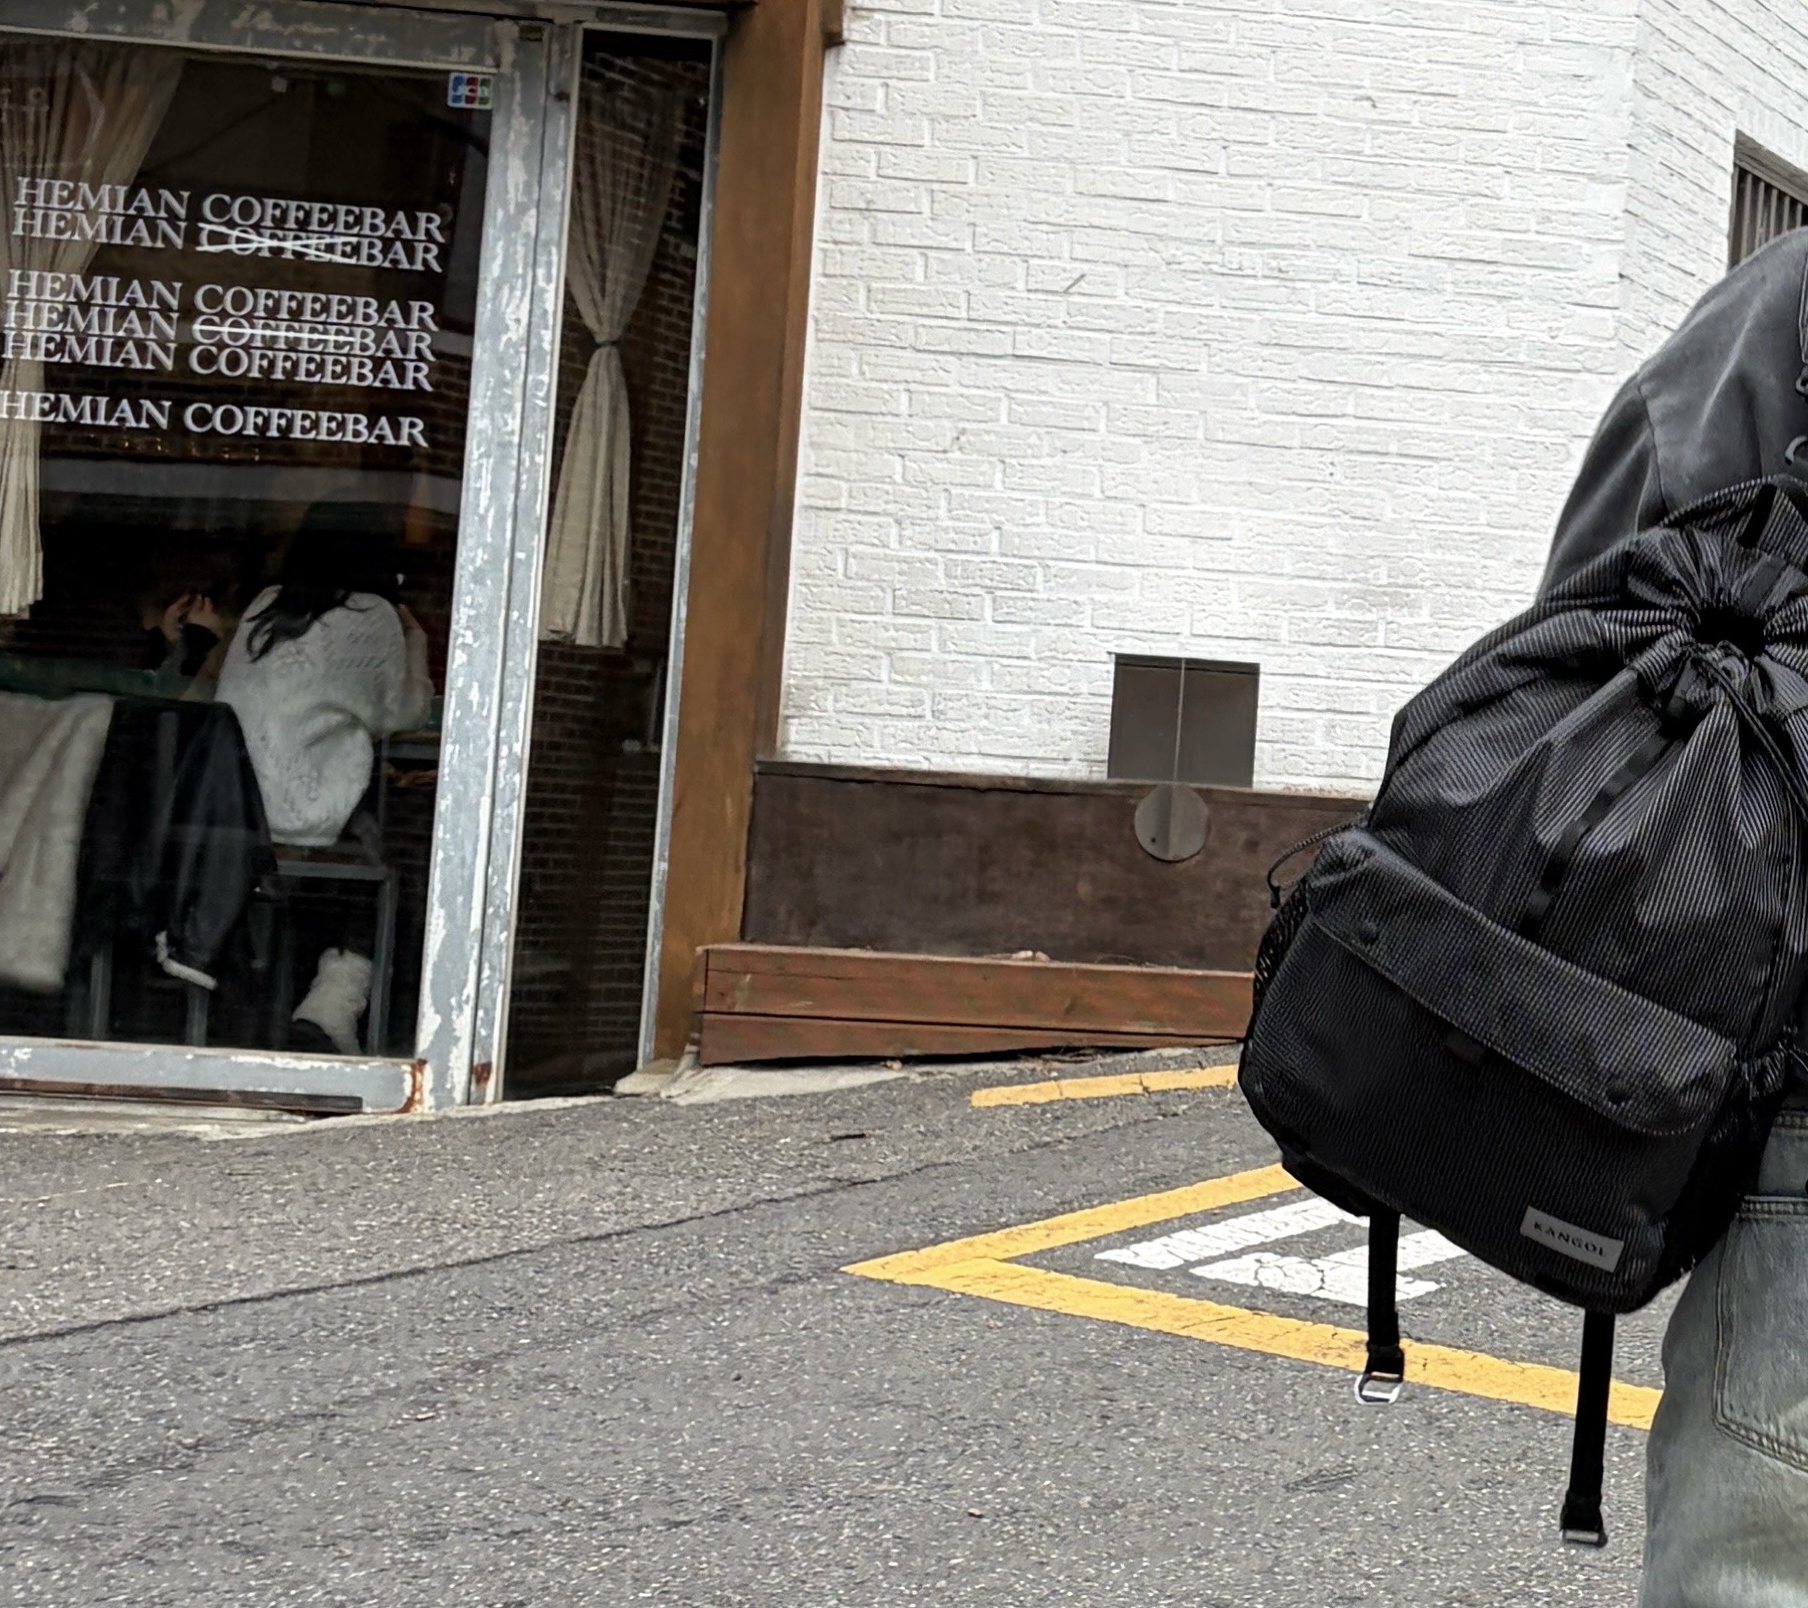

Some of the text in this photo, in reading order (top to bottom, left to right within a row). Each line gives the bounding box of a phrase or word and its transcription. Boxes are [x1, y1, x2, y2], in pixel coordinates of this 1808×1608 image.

[12, 207, 187, 250] HEMIAN
[14, 176, 445, 243] HEMIAN COFFEEBAR
[4, 300, 179, 340] HEMIAN
[7, 269, 439, 331] HEMIAN COFFEEBAR
[1, 330, 433, 391] HEMIAN COFFEEBAR
[0, 390, 428, 448] HEMIAN COFFEEBAR
[1533, 1220, 1607, 1258] KANGOL
